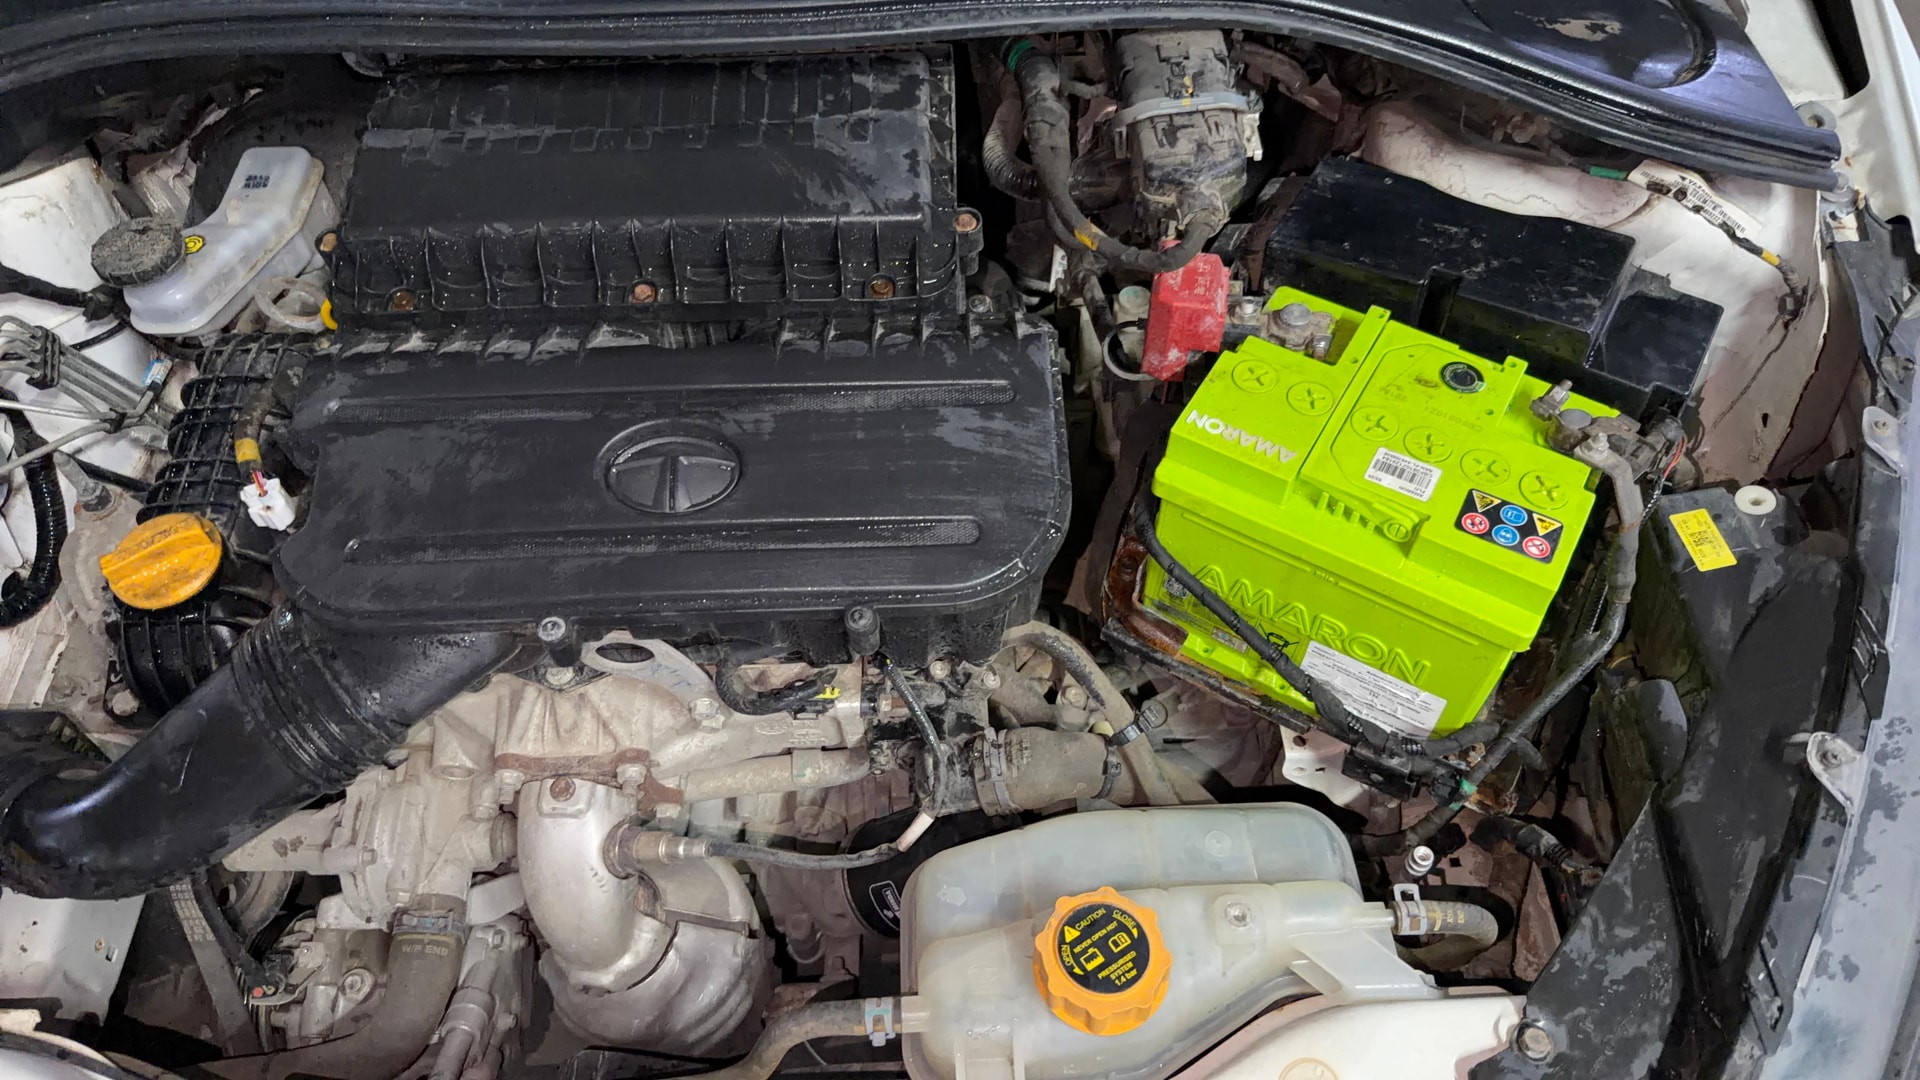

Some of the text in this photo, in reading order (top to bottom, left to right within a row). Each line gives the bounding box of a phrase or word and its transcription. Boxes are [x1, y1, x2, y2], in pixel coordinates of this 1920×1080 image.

[1186, 409, 1296, 463] AMARON
[1193, 564, 1430, 686] AMARON
[1075, 907, 1106, 930] CAUTION
[1113, 909, 1136, 930] CLOSE
[1073, 921, 1118, 953] NEVER OPEN HOT
[425, 945, 449, 956] END
[1061, 944, 1073, 966] OPEN
[1110, 961, 1133, 979] SYSTEM
[1125, 968, 1138, 979] bar
